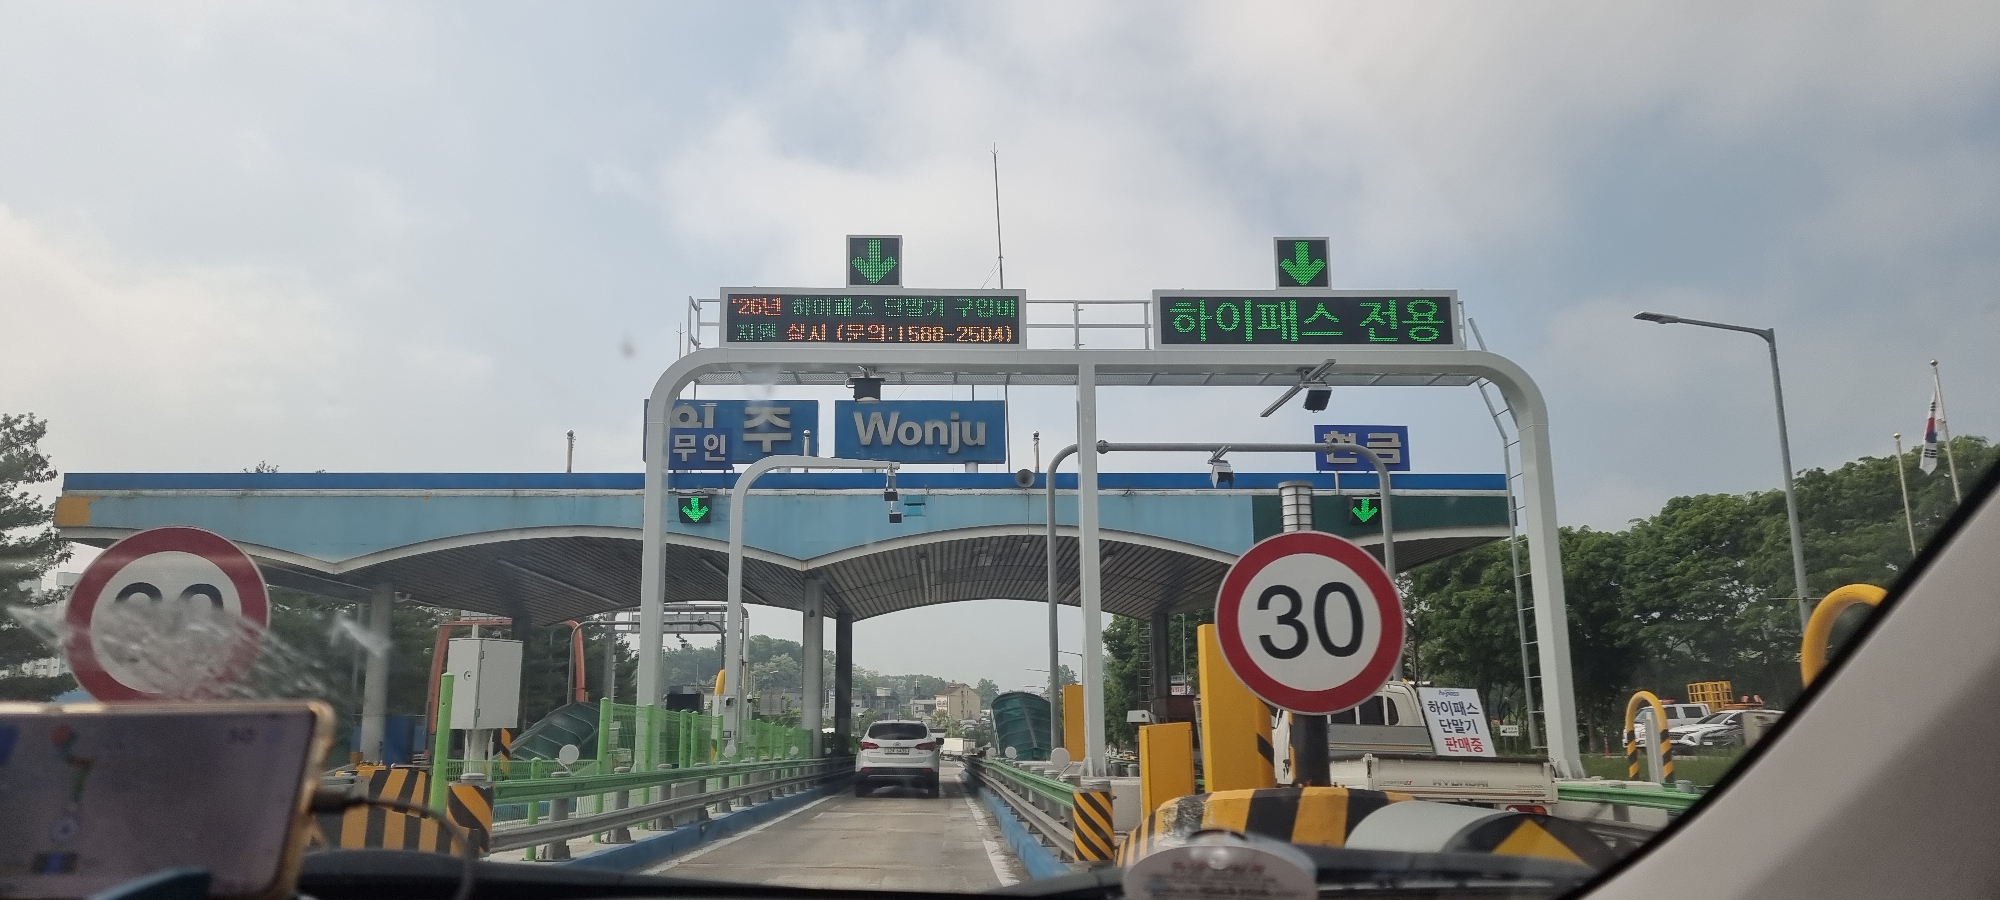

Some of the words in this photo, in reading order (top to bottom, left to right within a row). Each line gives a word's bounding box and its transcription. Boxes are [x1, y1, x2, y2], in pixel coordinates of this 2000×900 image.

[792, 298, 875, 317] 하이패스
[884, 298, 945, 318] 단말기
[954, 298, 1015, 318] 구입비
[1169, 299, 1344, 342] 하이패스
[1359, 299, 1445, 342] 전용
[735, 323, 777, 341] 지원
[786, 323, 827, 342] 실시
[853, 411, 986, 454] Wonju
[672, 434, 726, 462] 무인
[1257, 581, 1364, 660] 30
[1427, 700, 1480, 716] 하이패스
[1438, 718, 1479, 734] 단말기
[1444, 736, 1484, 753] 판매중
